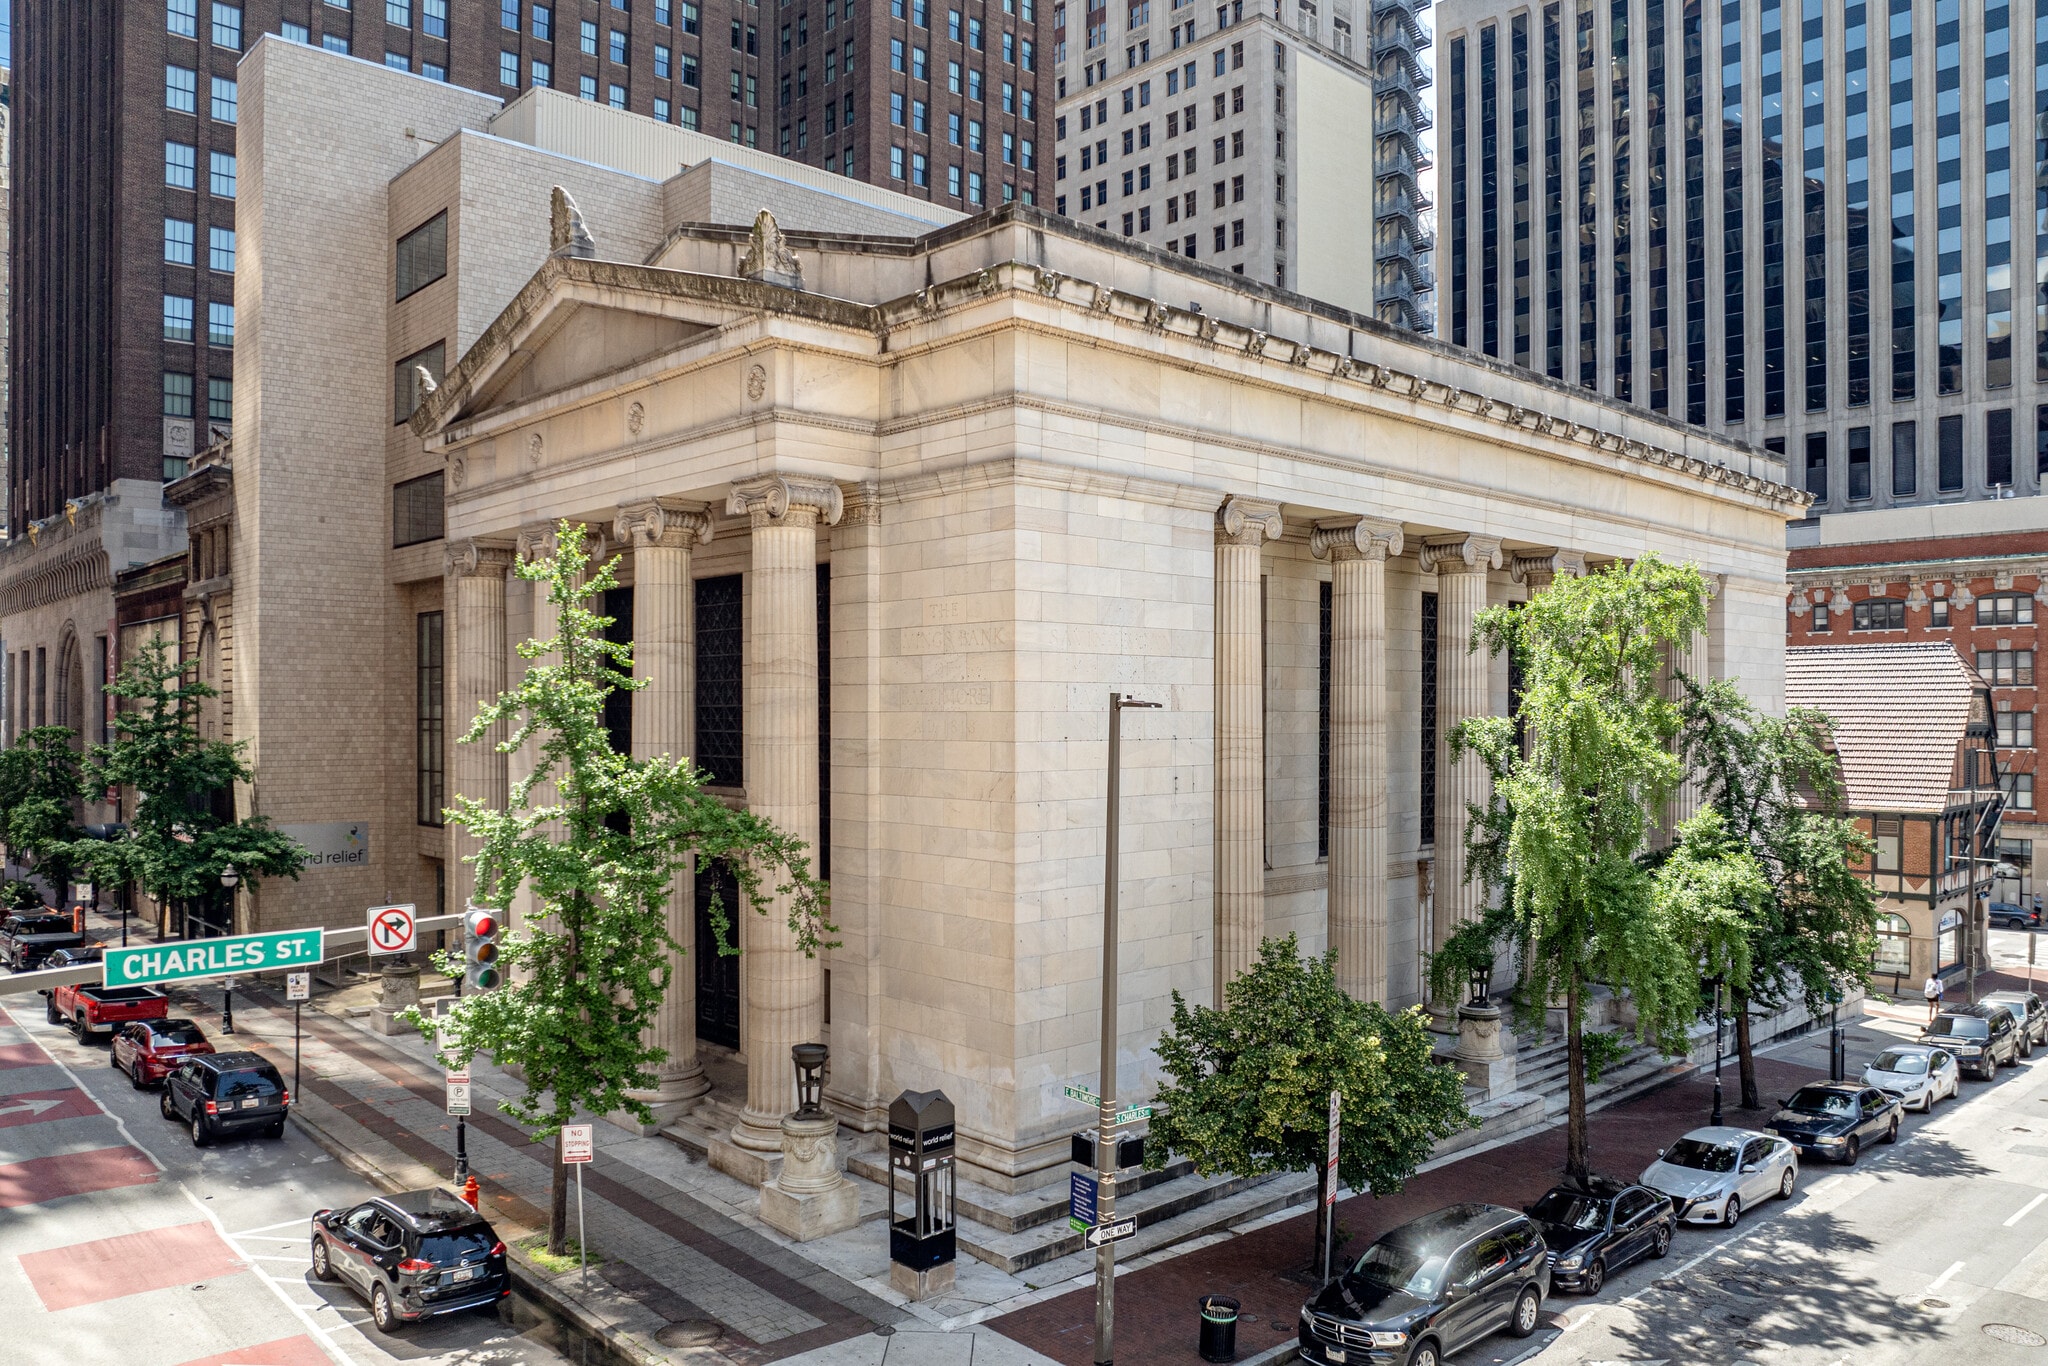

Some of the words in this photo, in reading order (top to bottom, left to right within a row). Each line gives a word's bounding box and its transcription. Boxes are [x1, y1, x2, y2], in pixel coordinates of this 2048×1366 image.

[929, 602, 959, 618] THE
[959, 627, 1005, 646] BANK
[326, 849, 363, 864] relief
[123, 941, 264, 980] CHARLES
[276, 939, 312, 959] ST.
[1069, 1089, 1096, 1105] BALTIMORE
[1116, 1113, 1121, 1124] S
[1121, 1109, 1144, 1122] CHARLES
[902, 1137, 915, 1146] relief
[923, 1135, 939, 1146] world
[939, 1131, 954, 1142] relief
[1100, 1228, 1115, 1239] ONE
[1117, 1223, 1131, 1234] WAY
